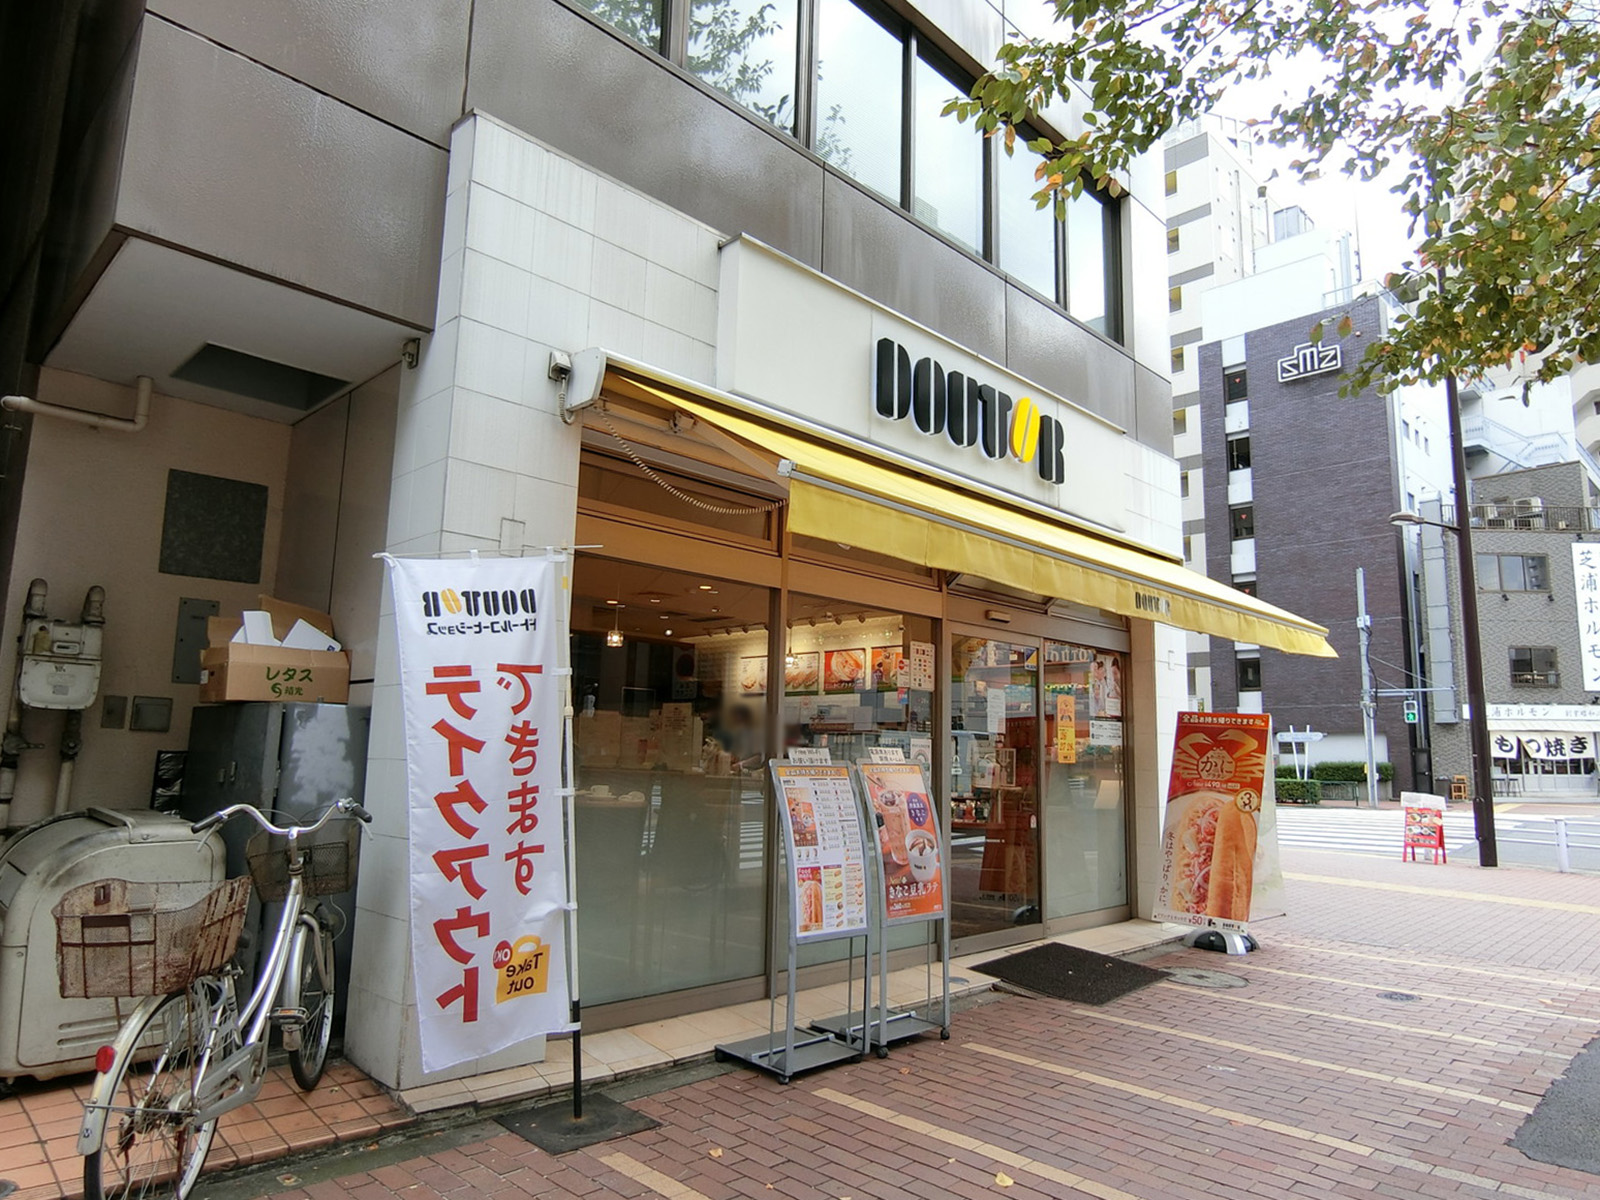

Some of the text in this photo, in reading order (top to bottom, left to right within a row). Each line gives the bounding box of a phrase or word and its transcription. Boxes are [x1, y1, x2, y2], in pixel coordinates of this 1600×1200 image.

[876, 337, 1065, 485] DOUTOR
[266, 667, 313, 682] レタス
[1494, 735, 1588, 757] もつ焼き
[1200, 755, 1233, 774] かに
